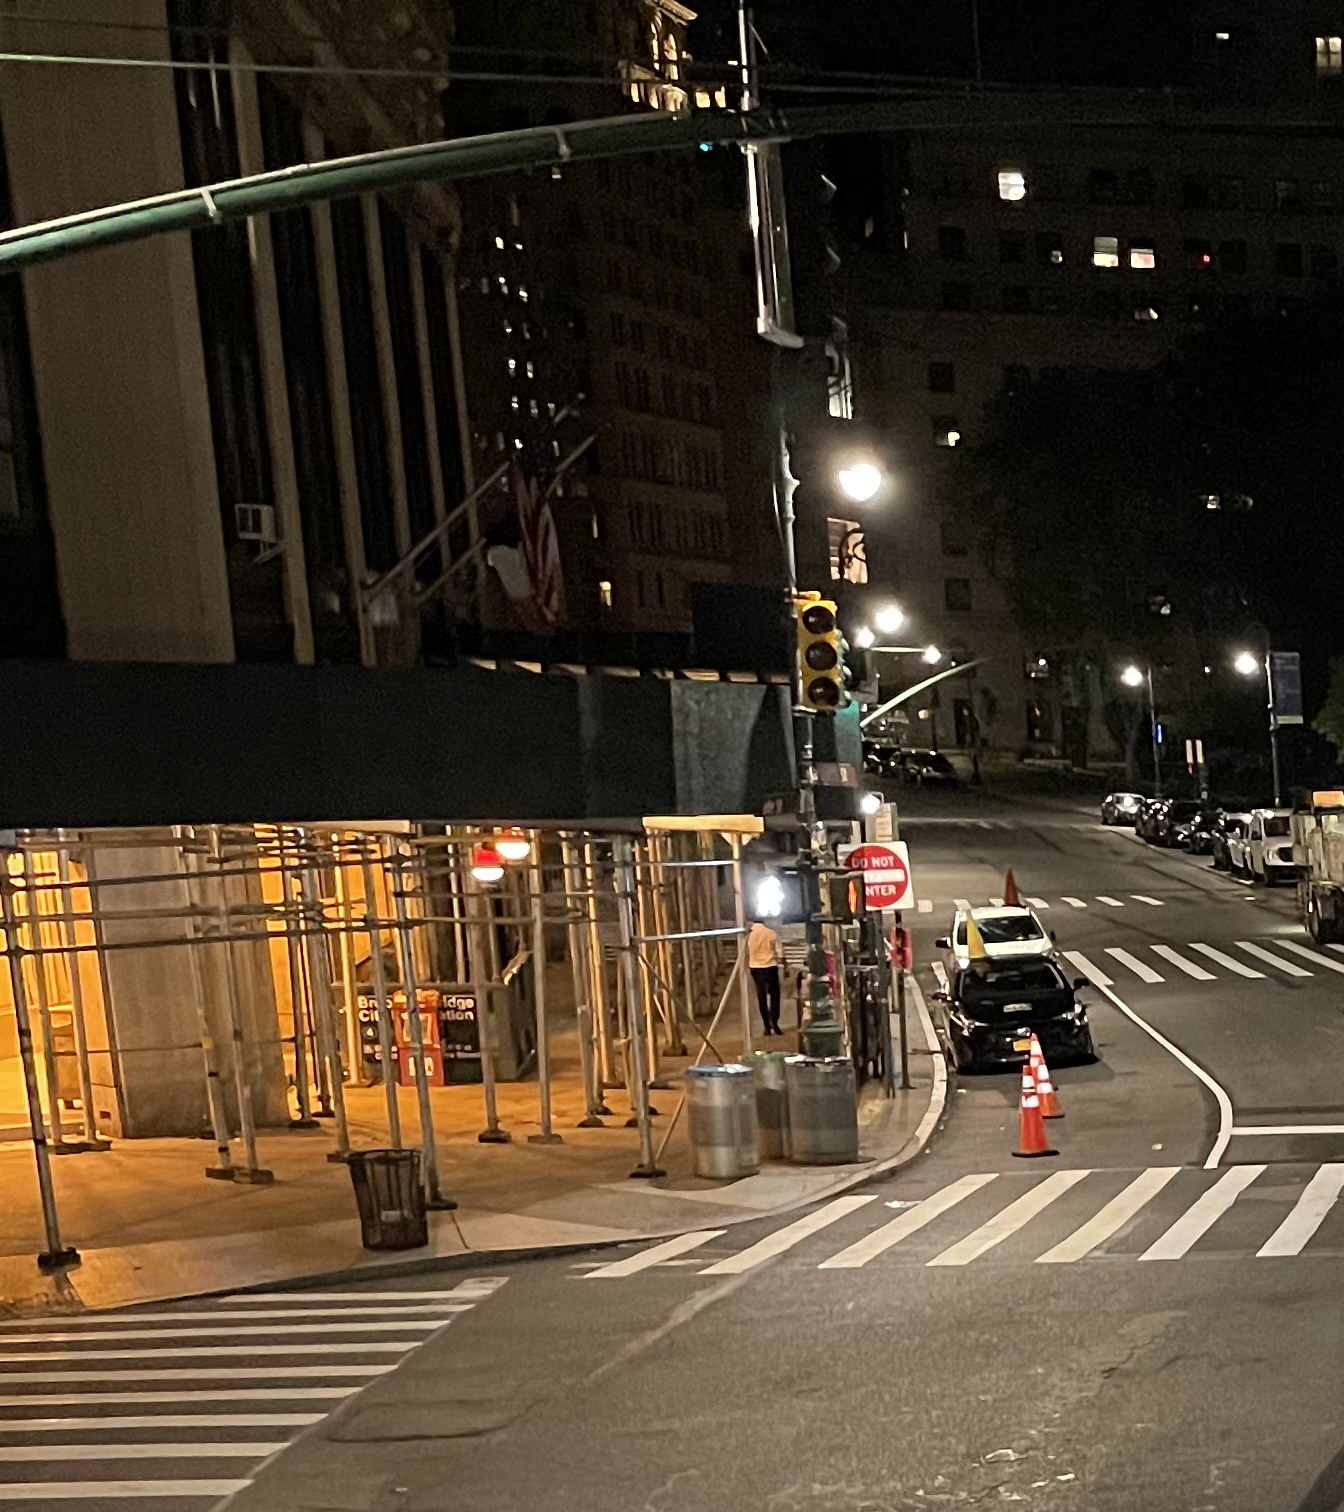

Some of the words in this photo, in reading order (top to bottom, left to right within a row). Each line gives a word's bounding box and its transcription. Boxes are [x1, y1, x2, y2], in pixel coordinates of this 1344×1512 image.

[851, 857, 869, 869] DO
[871, 855, 895, 868] NOT
[865, 884, 897, 897] NTER
